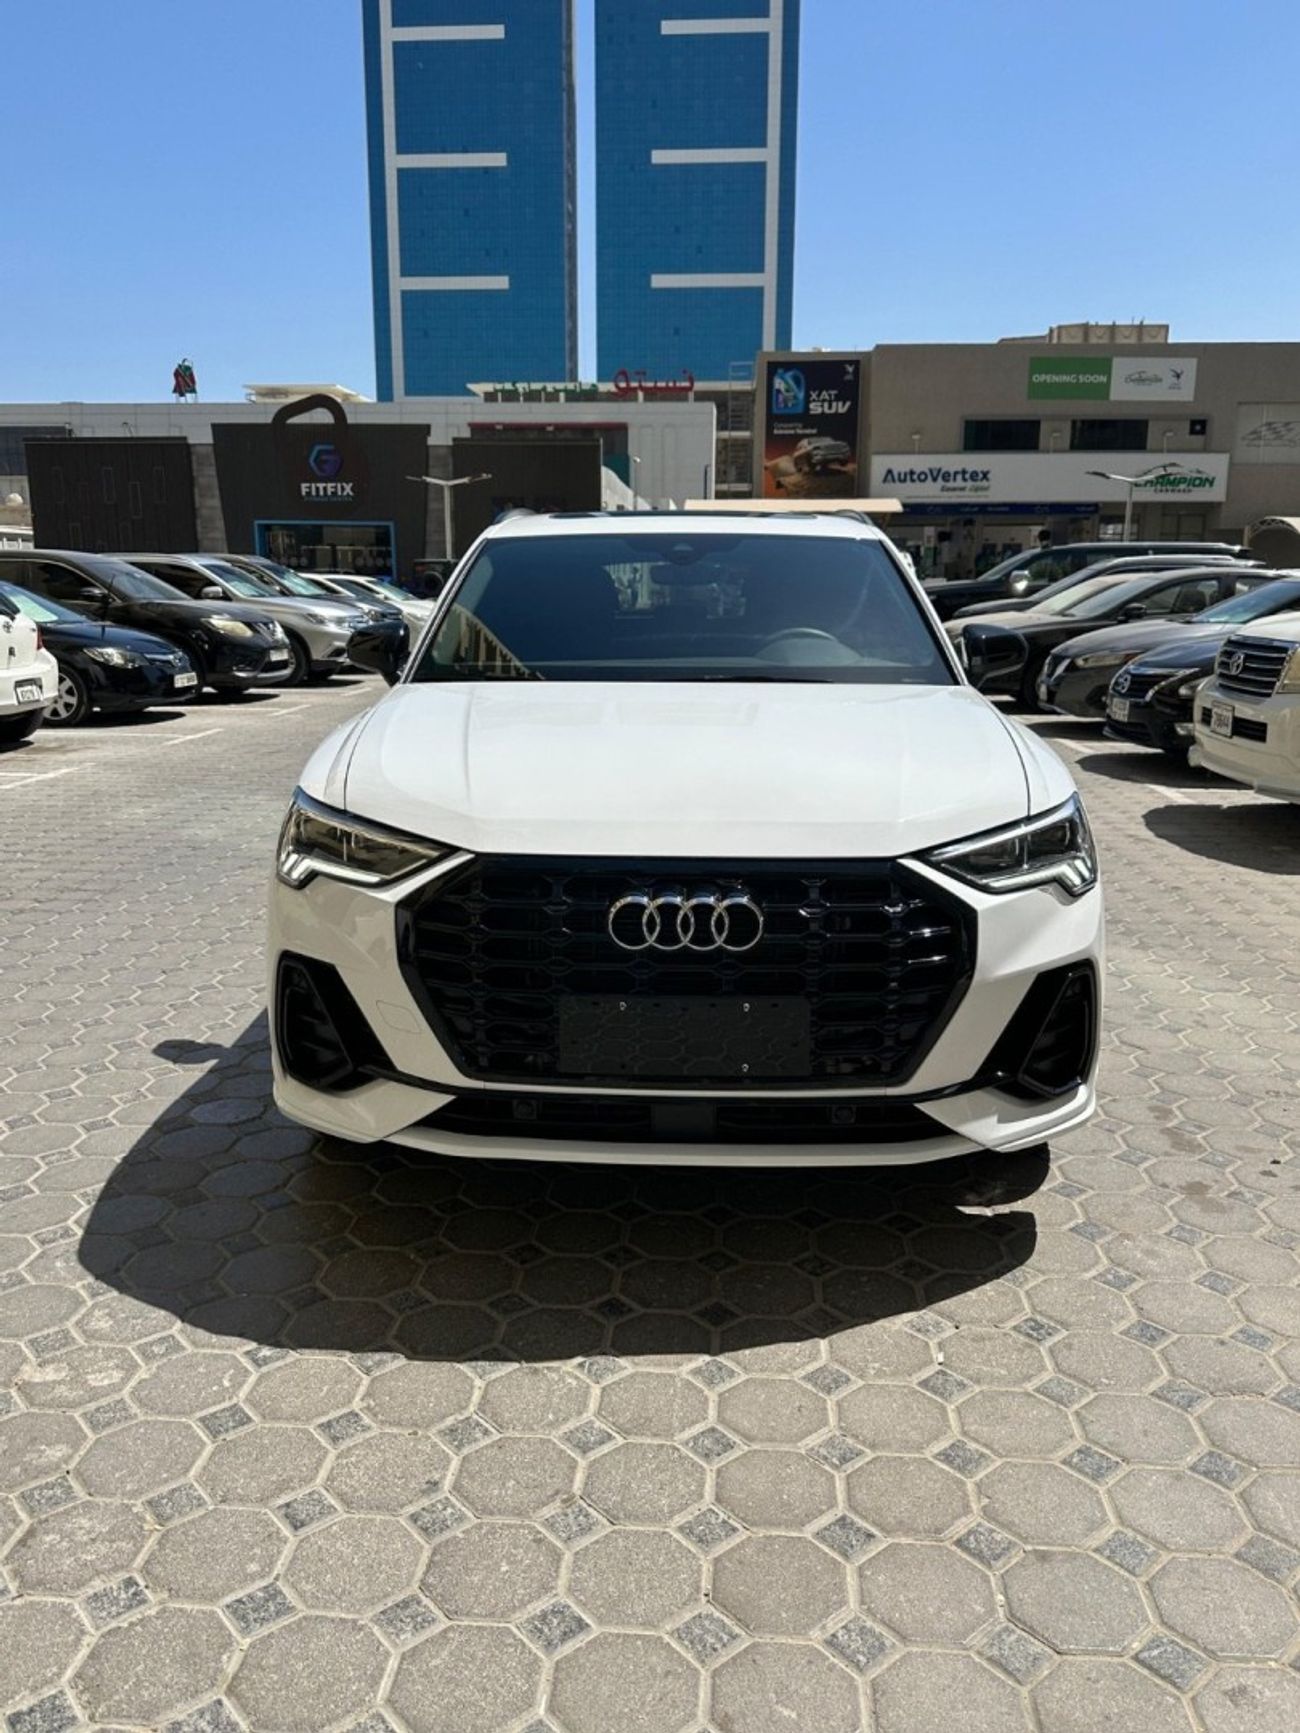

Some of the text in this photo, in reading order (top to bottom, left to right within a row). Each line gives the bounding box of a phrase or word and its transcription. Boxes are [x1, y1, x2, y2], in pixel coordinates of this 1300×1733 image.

[1032, 373, 1107, 383] OPENING SOON
[809, 389, 838, 401] XAT
[809, 401, 851, 414] SUV
[882, 467, 991, 484] AutoVertex
[300, 482, 354, 496] FITFIX
